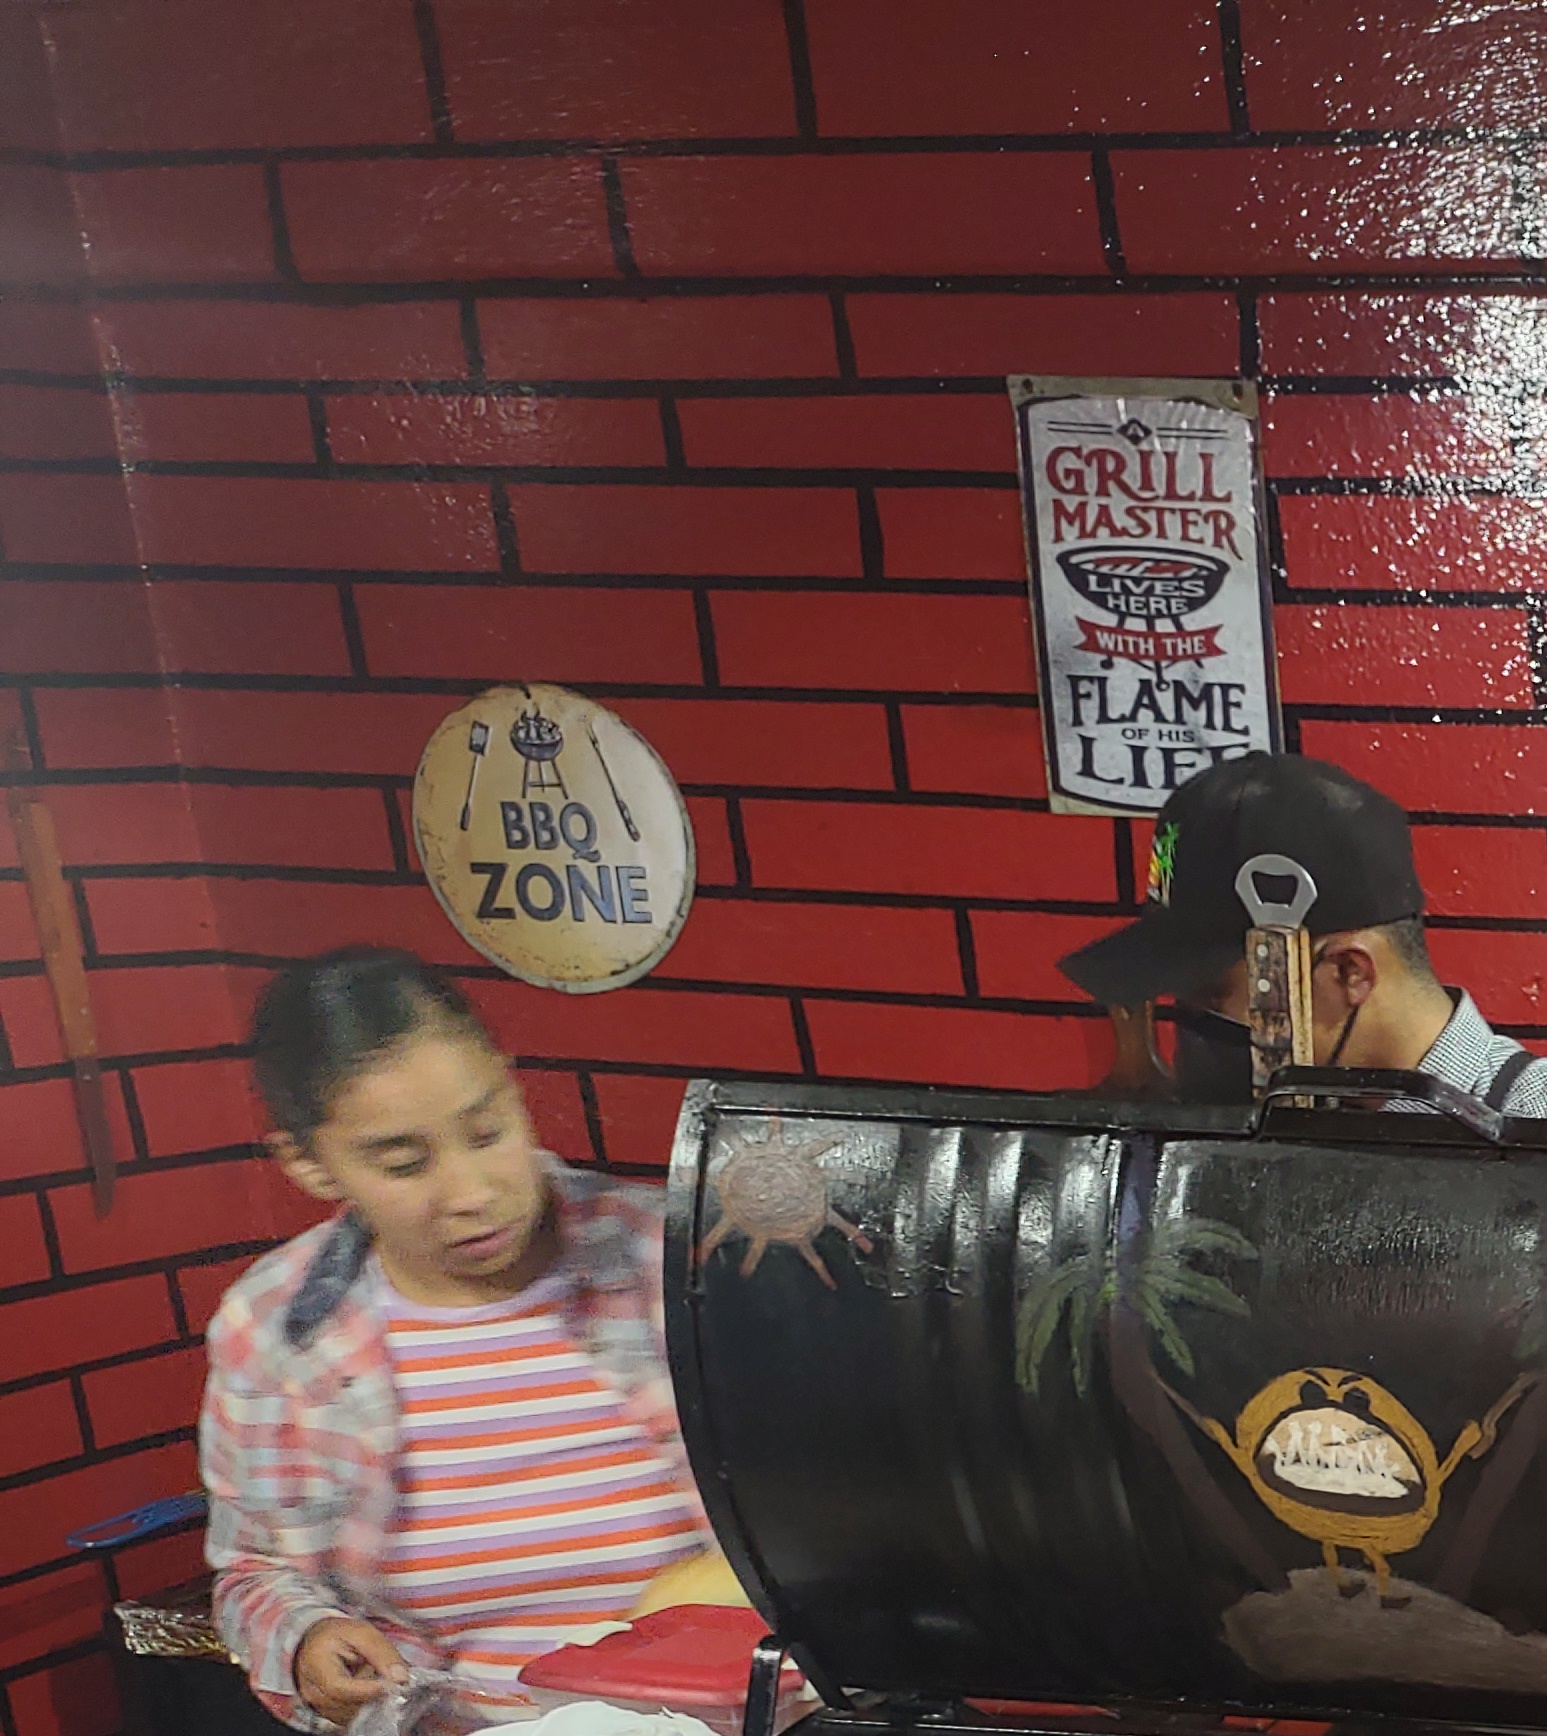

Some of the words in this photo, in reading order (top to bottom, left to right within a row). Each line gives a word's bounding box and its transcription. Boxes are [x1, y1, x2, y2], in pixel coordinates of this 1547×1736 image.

[1045, 445, 1232, 502] GRILL
[1051, 499, 1243, 560] MASTER
[1087, 574, 1206, 597] LIVES
[1106, 597, 1189, 616] HERE
[1095, 631, 1157, 656] WITH
[1161, 636, 1207, 656] THE
[1066, 674, 1251, 736] FLAME
[1121, 727, 1151, 742] OF
[1158, 729, 1195, 743] HIS
[500, 801, 601, 862] BBQ
[470, 862, 652, 924] ZONE
